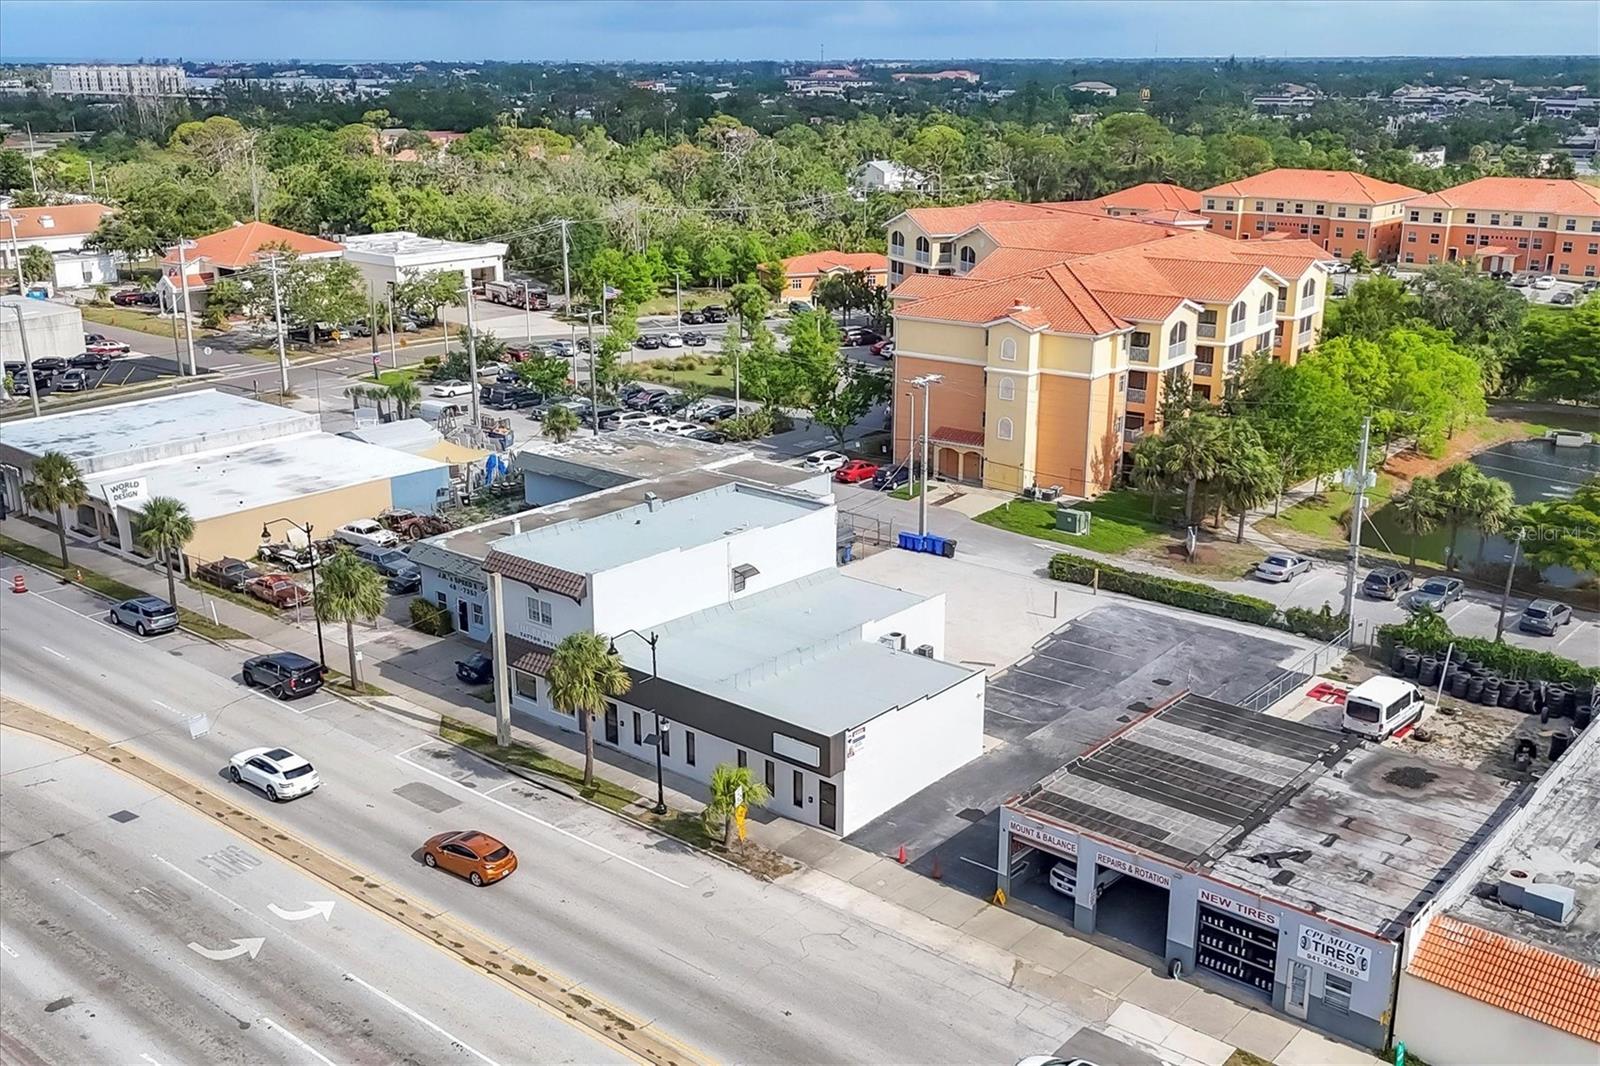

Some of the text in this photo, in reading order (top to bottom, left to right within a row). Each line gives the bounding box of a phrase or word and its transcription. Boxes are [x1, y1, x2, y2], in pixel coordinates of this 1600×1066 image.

[110, 481, 140, 493] WORLD
[113, 491, 138, 501] DESIGN
[1010, 821, 1077, 853] MOUNT & BALANCE
[1097, 853, 1170, 886] REPAIRS & ROTATION
[1201, 890, 1276, 924] NEW TIRES
[1305, 928, 1365, 955] CPL MULTI
[1312, 940, 1356, 965] TIRES
[1306, 953, 1360, 977] 941-244-2182
